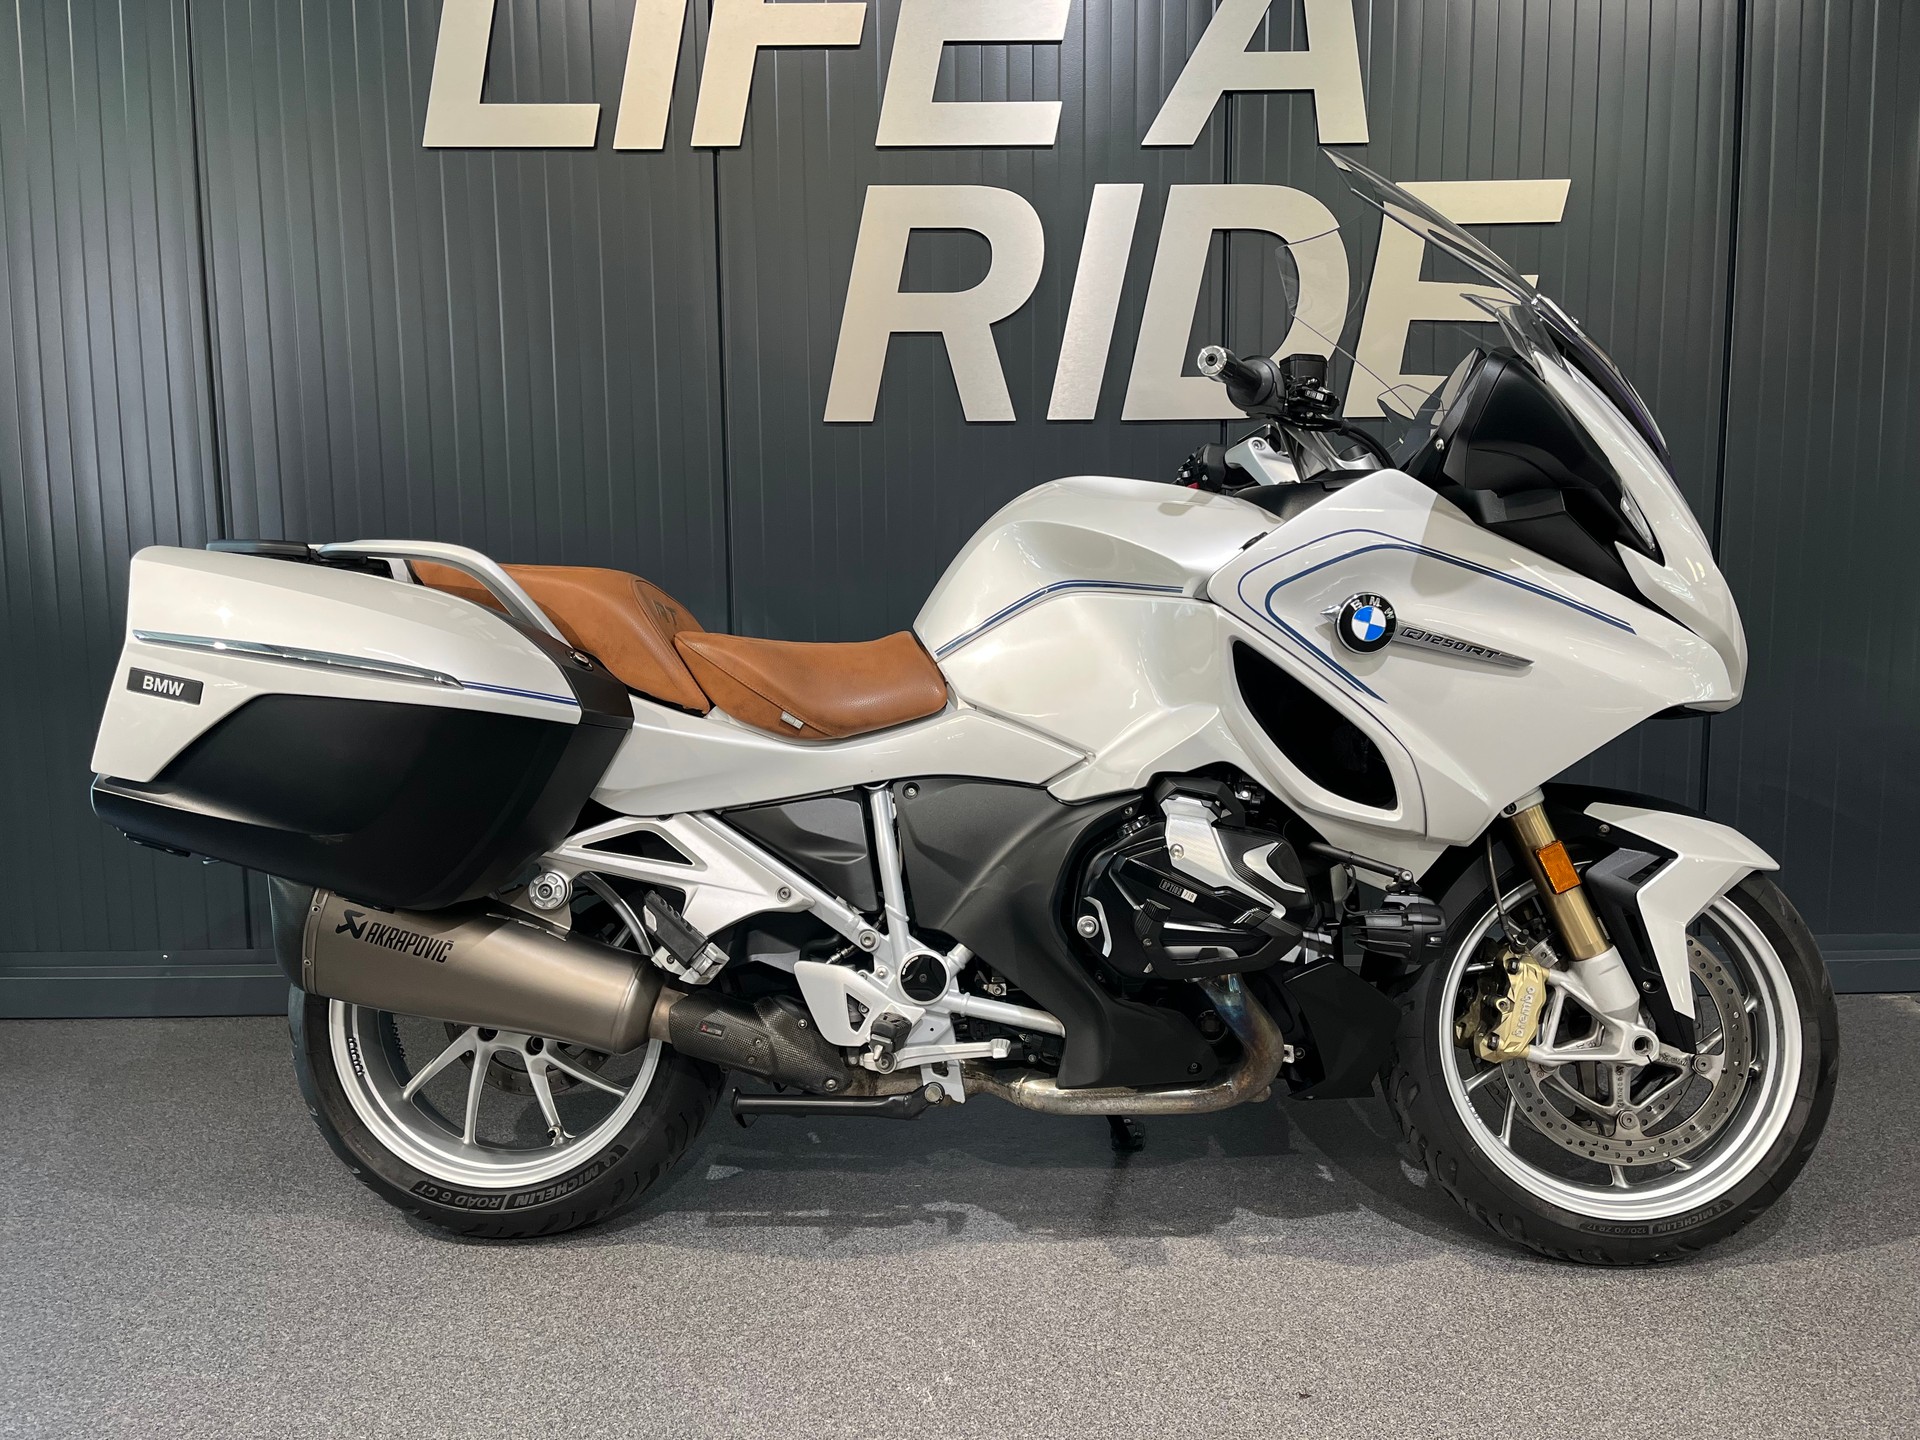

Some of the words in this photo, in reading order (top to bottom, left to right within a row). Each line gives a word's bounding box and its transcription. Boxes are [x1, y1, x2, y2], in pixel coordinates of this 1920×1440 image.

[422, 0, 1068, 149] LIFE
[1141, 0, 1369, 145] A
[823, 178, 1571, 422] RIDE
[1351, 596, 1395, 620] BMW
[142, 675, 185, 697] BMW
[364, 922, 455, 964] AKRAPOVIČ
[1512, 985, 1536, 1039] brembo
[415, 1183, 440, 1199] GT
[440, 1190, 453, 1202] 6
[513, 1162, 600, 1208] MICHELIN
[454, 1194, 502, 1209] ROAD
[1656, 1210, 1714, 1233] MICHELIN
